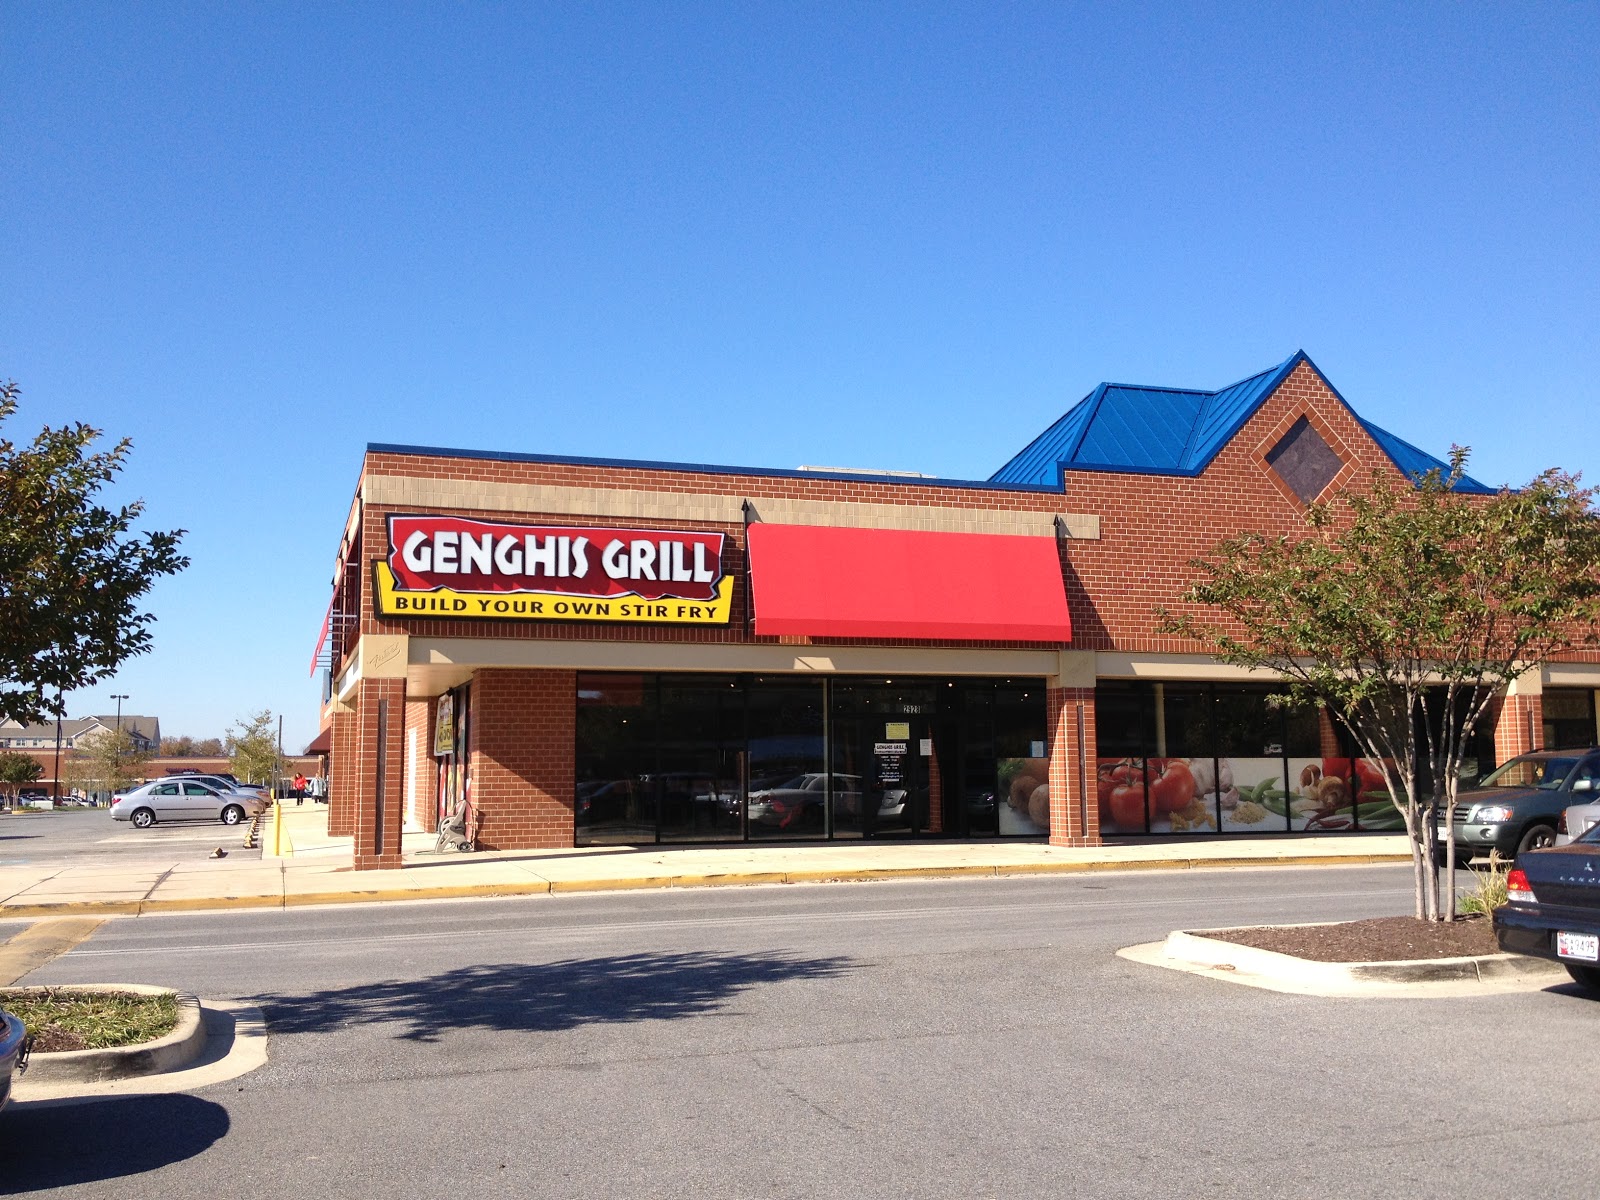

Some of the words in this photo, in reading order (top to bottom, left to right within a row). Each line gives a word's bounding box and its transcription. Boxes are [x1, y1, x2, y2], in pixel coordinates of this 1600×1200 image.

[402, 530, 589, 579] GENGHIS
[602, 539, 714, 582] GRILL
[395, 597, 467, 610] BUILD
[478, 599, 543, 613] YOUR
[554, 602, 610, 615] OWN
[620, 604, 668, 617] STIR
[677, 606, 717, 619] FRY
